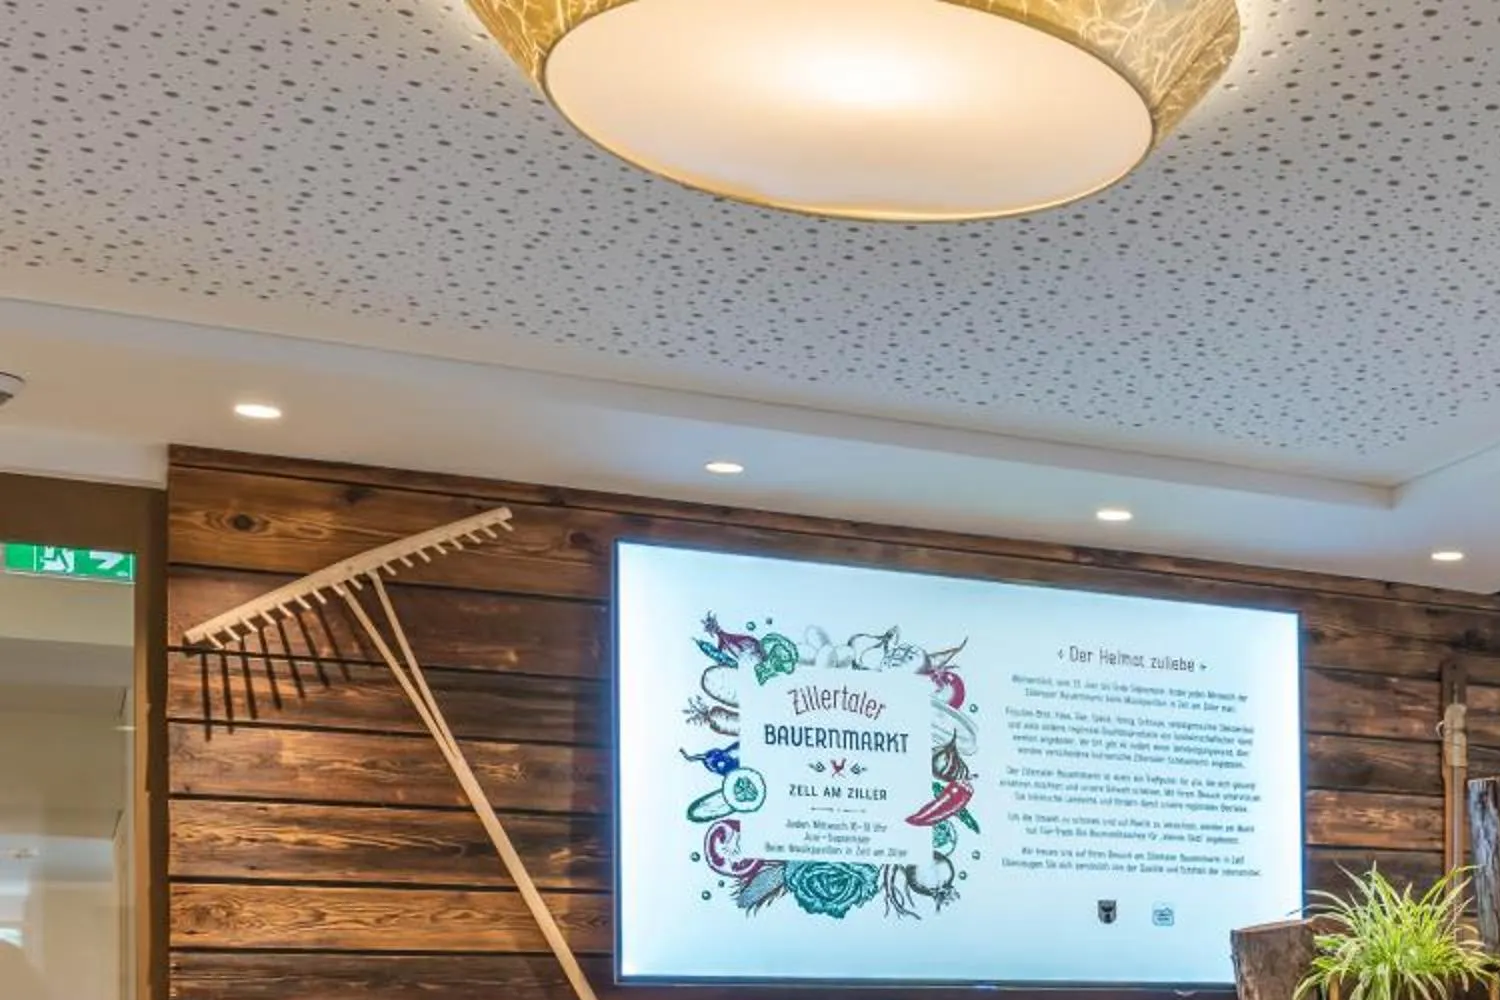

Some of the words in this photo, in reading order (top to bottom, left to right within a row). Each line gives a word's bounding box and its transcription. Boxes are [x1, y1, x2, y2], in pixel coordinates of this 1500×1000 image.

[1069, 645, 1093, 663] Der
[1099, 648, 1145, 668] Heimat
[1150, 656, 1195, 673] zuliebe
[787, 685, 887, 721] Zillertaler
[764, 724, 909, 754] BAUERNMARKT
[789, 784, 819, 797] ZELL
[823, 787, 842, 799] AM
[847, 788, 888, 801] ZILLER
